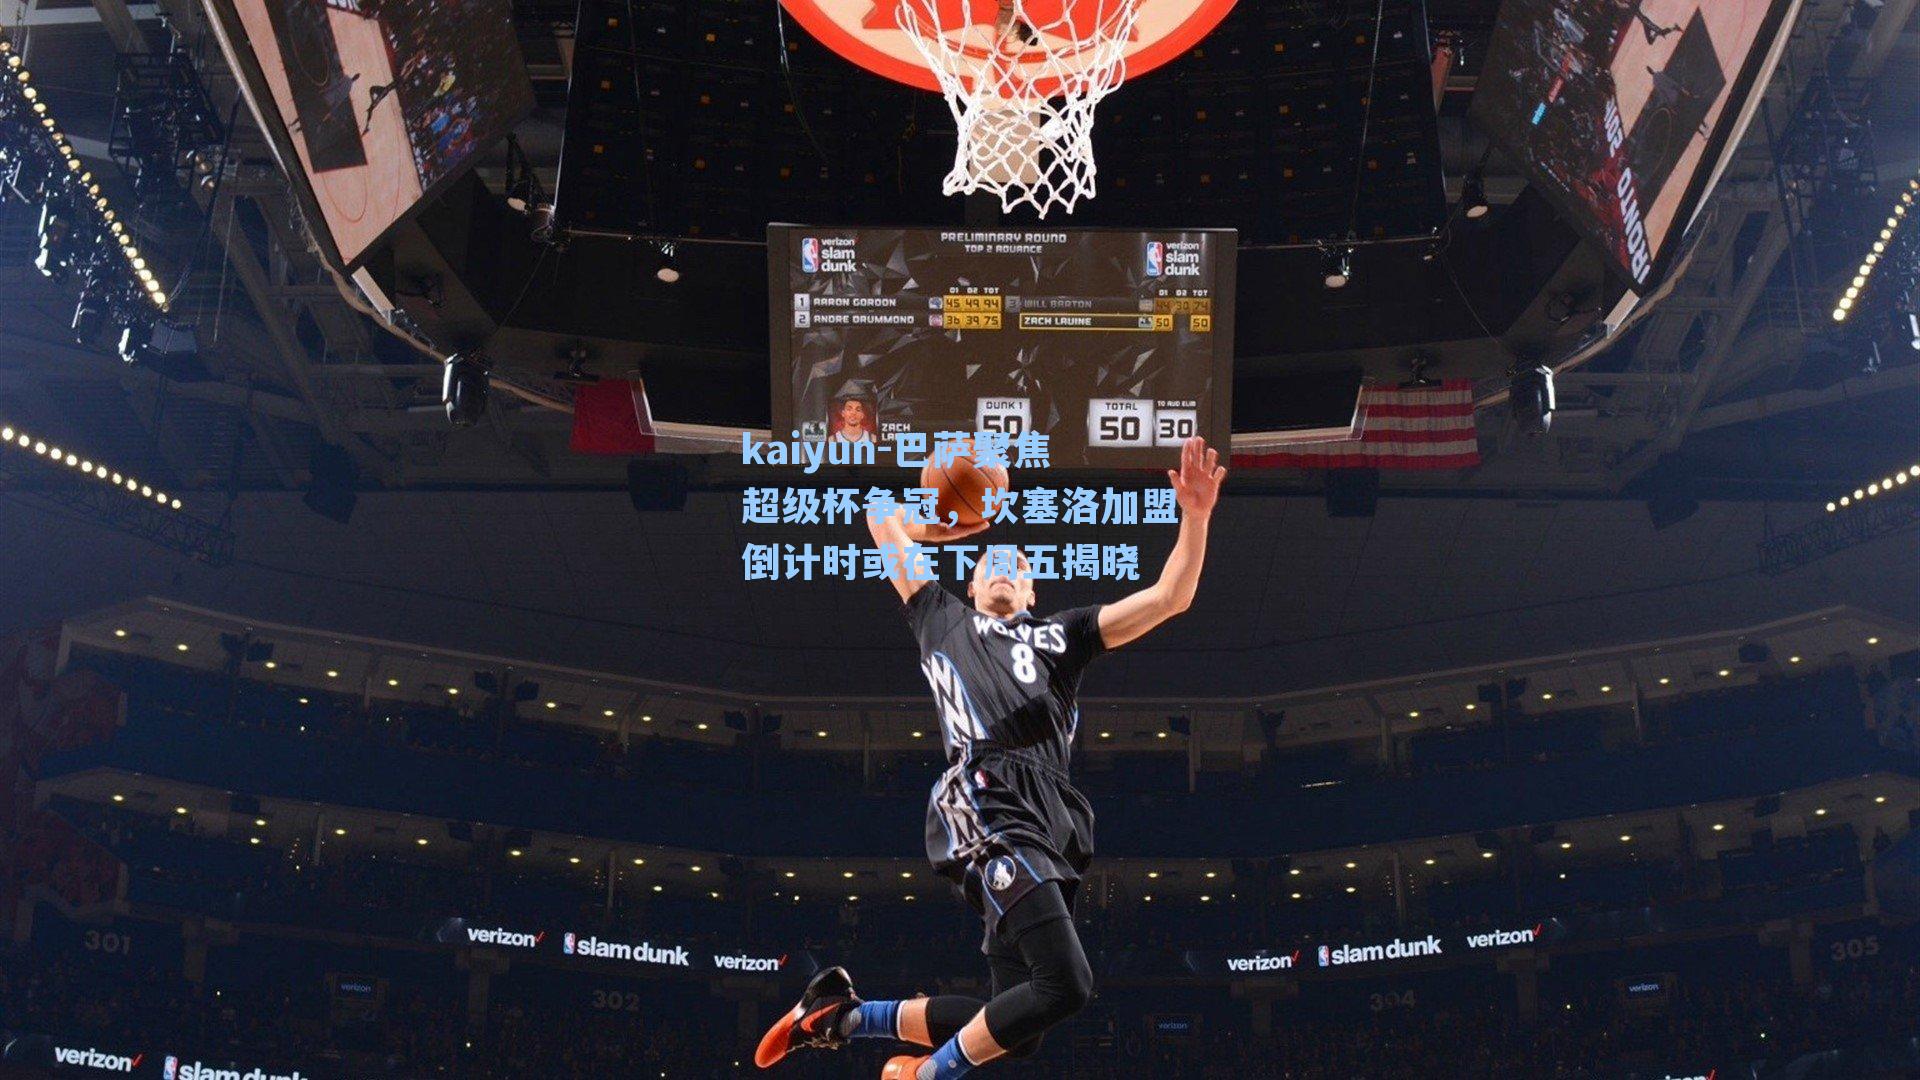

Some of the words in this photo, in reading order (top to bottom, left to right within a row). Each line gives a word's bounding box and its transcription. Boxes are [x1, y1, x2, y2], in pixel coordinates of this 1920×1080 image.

[821, 238, 855, 246] verizon
[941, 232, 1021, 242] PRELIMINARY
[1025, 233, 1067, 243] ROUND
[964, 244, 983, 252] TOP
[1166, 242, 1199, 250] verizon
[821, 247, 856, 259] slam
[1165, 251, 1200, 263] slam
[821, 260, 857, 272] dunk
[1165, 263, 1200, 276] dunk
[813, 298, 849, 307] AARON
[853, 298, 896, 307] GORDON
[946, 299, 959, 308] 45
[965, 299, 980, 308] 49
[984, 299, 999, 308] 94
[1050, 300, 1092, 309] BARTON
[813, 315, 849, 324] ANDRE
[852, 315, 915, 324] DRUMMOND
[966, 316, 980, 325] 39
[984, 316, 999, 325] 75
[1024, 317, 1052, 325] ZACH
[1156, 318, 1170, 328] 50
[1193, 319, 1208, 328] 50
[986, 401, 1015, 410] DUNK
[1105, 402, 1138, 411] TOTAL
[881, 423, 911, 432] ZACH
[1100, 416, 1140, 441] 50
[1159, 418, 1193, 439] 30
[973, 616, 1067, 654] WOLVES
[1011, 643, 1037, 683] 8
[85, 930, 131, 953] 301
[467, 928, 536, 947] verizon
[1467, 929, 1534, 948] verizon
[577, 936, 631, 959] slam
[633, 942, 689, 966] dunk
[1331, 942, 1383, 964] slam
[1386, 935, 1442, 958] dunk
[1831, 936, 1880, 961] 305
[714, 954, 779, 971] verizon
[1227, 954, 1292, 971] verizon
[592, 990, 640, 1011] 302
[55, 1047, 131, 1072] verizon
